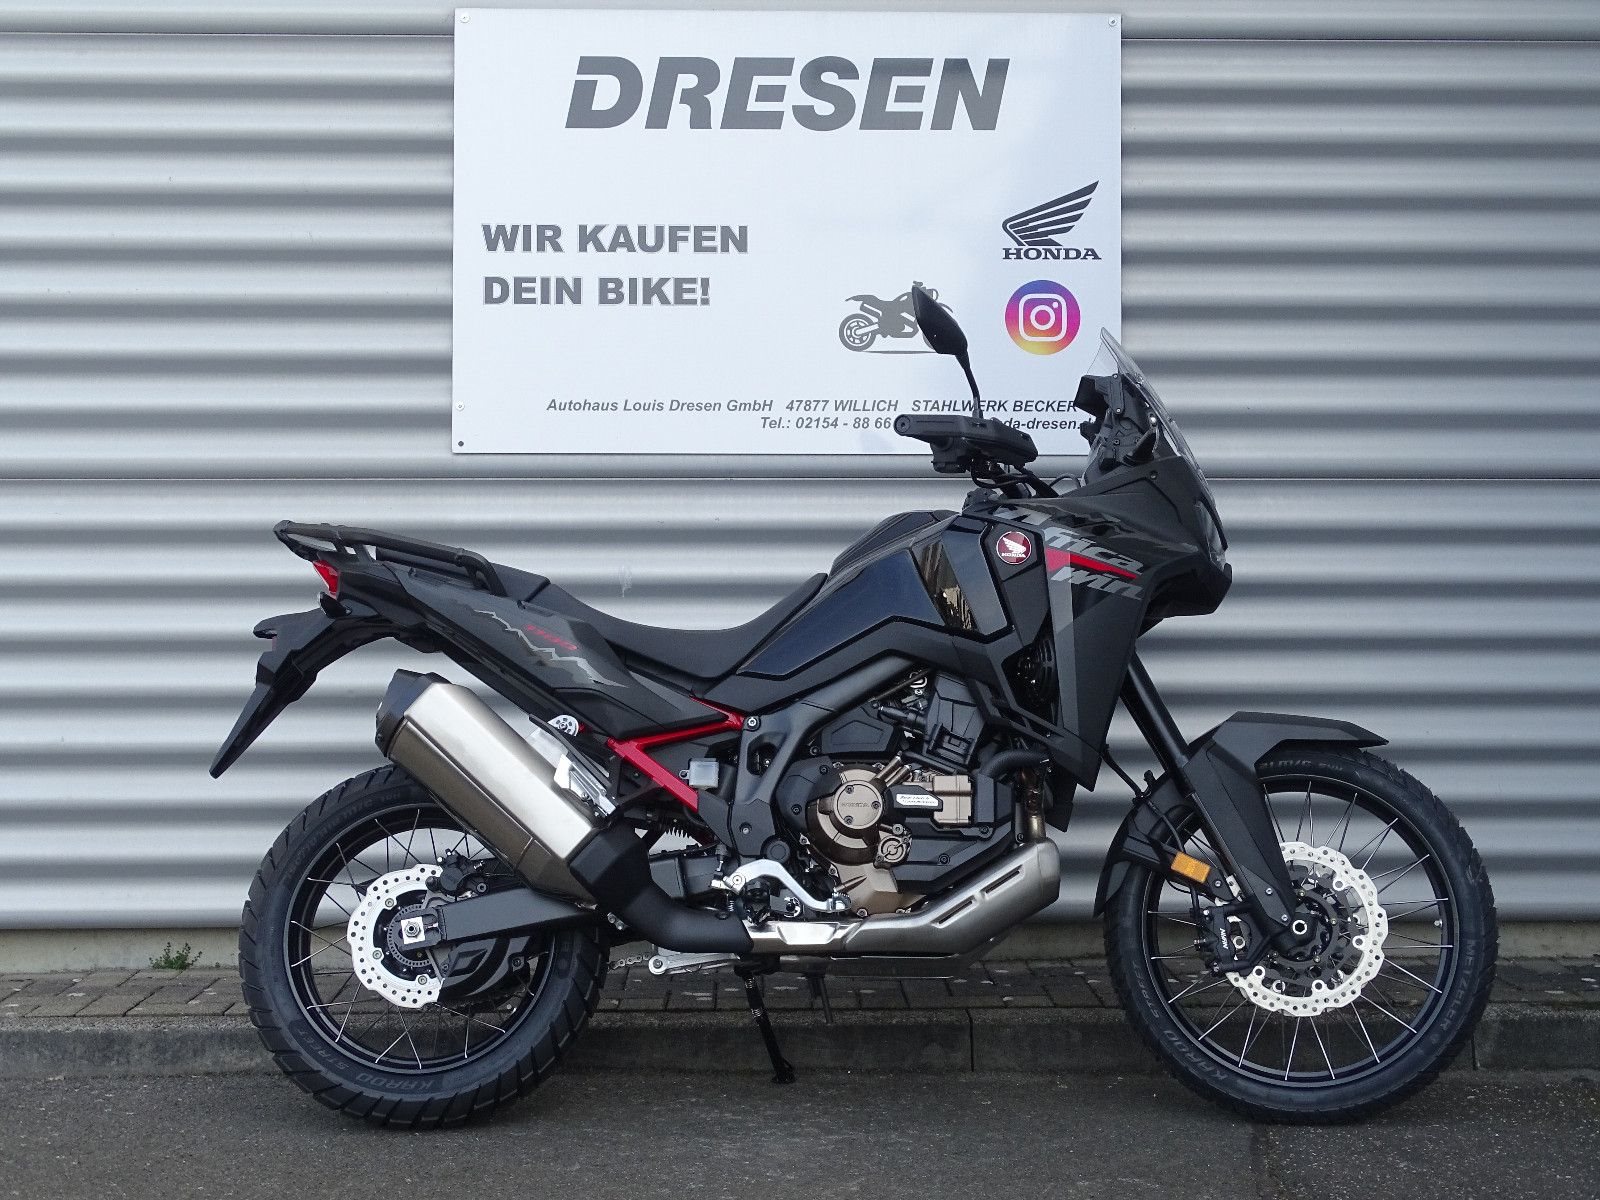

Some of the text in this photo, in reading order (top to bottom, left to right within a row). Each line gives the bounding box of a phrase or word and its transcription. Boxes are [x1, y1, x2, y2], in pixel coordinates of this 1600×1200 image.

[565, 56, 1010, 131] DRESEN
[482, 224, 749, 253] WIR KAUFEN
[1002, 247, 1102, 260] HONDA
[483, 276, 710, 305] DEIN BIKE!
[546, 399, 1077, 412] Autohaus Louis Dresen GmbH 47877 WILLICH STAHLWERK BECKER
[761, 416, 791, 429] Tel.:
[795, 416, 839, 429] 02154
[852, 416, 870, 429] 88
[874, 416, 892, 429] 66
